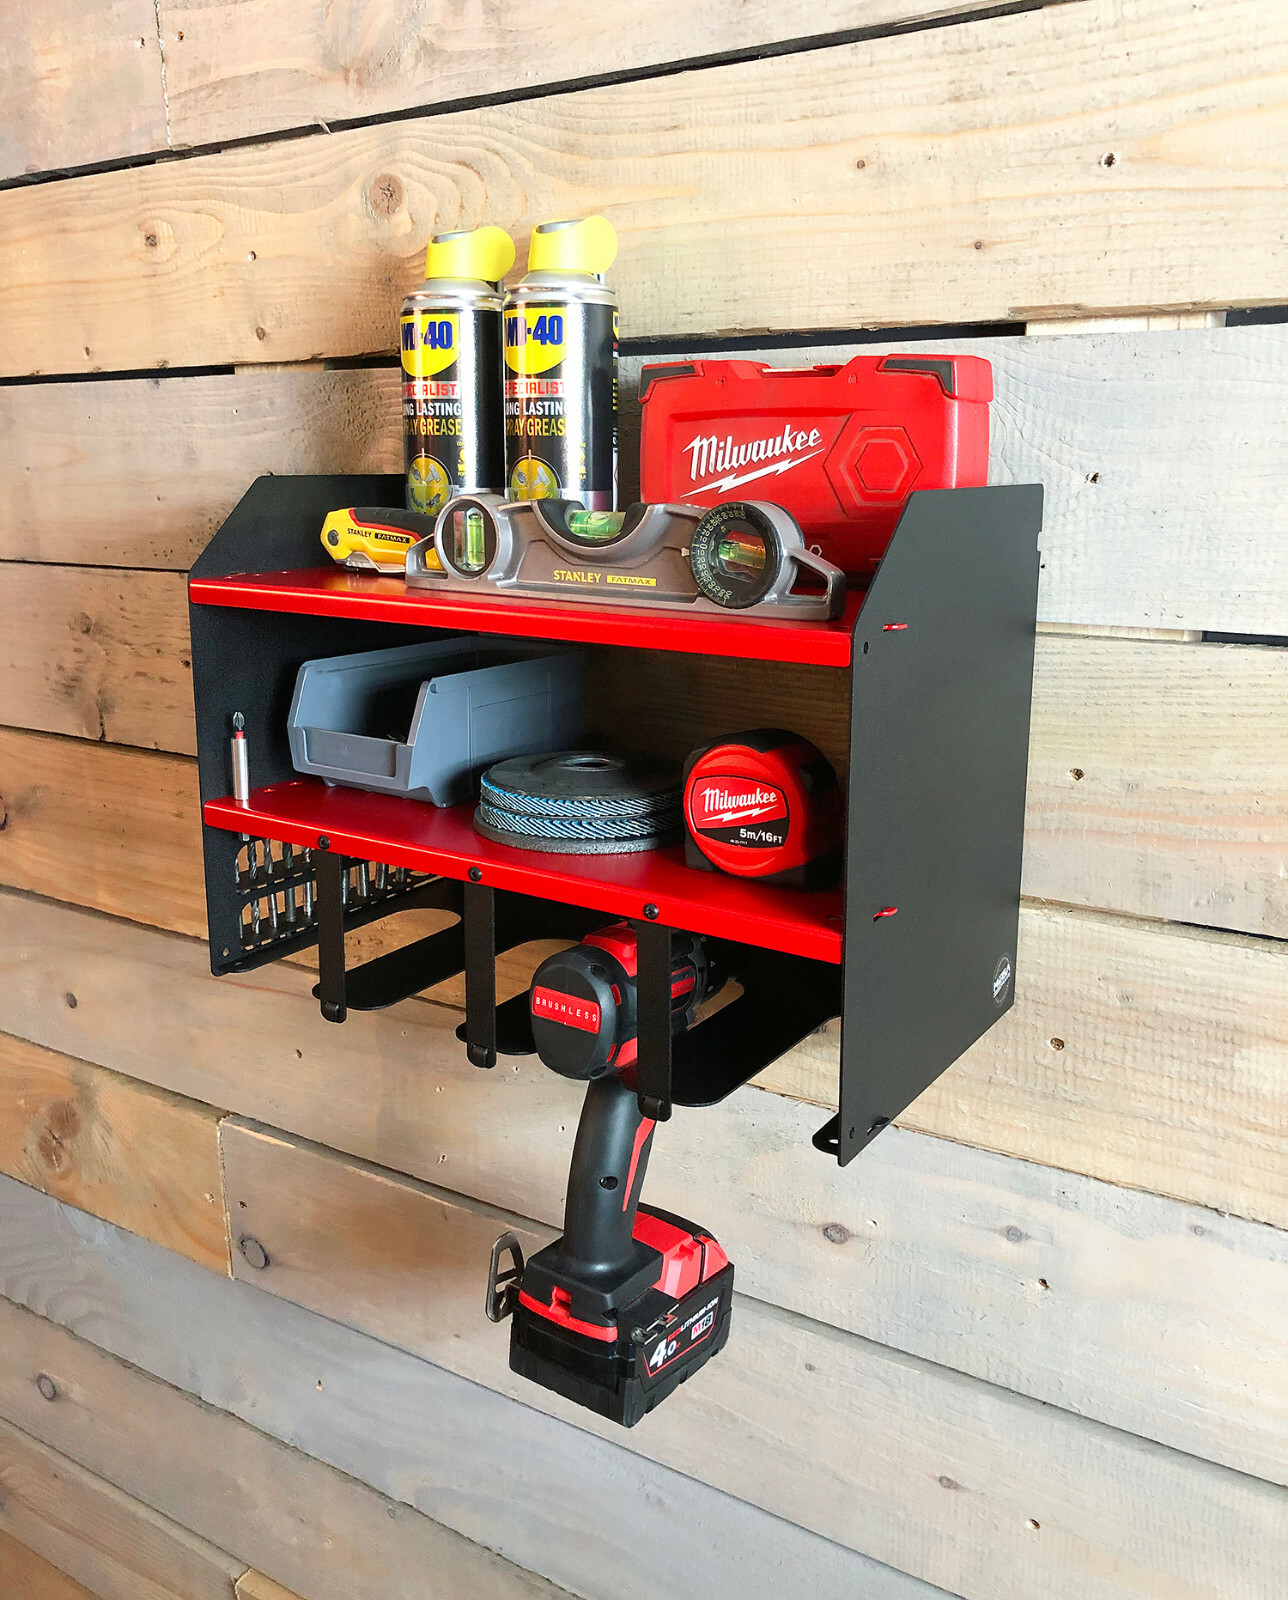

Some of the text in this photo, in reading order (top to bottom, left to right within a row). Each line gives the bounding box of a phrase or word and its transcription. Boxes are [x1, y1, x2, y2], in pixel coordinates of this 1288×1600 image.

[505, 315, 563, 347] WD-40
[402, 383, 457, 397] PECALIST
[416, 402, 462, 416] LASTING
[505, 401, 520, 416] ONG
[420, 418, 463, 436] GREASE
[505, 418, 566, 437] PRAY GREAS
[681, 424, 823, 481] Milwaukee
[347, 528, 408, 543] STANLEY FATMAX
[553, 569, 651, 585] STANLEY FATMAX
[699, 787, 778, 813] Milwaukee
[535, 996, 597, 1022] BRUSHLESS
[692, 1313, 712, 1336] M18
